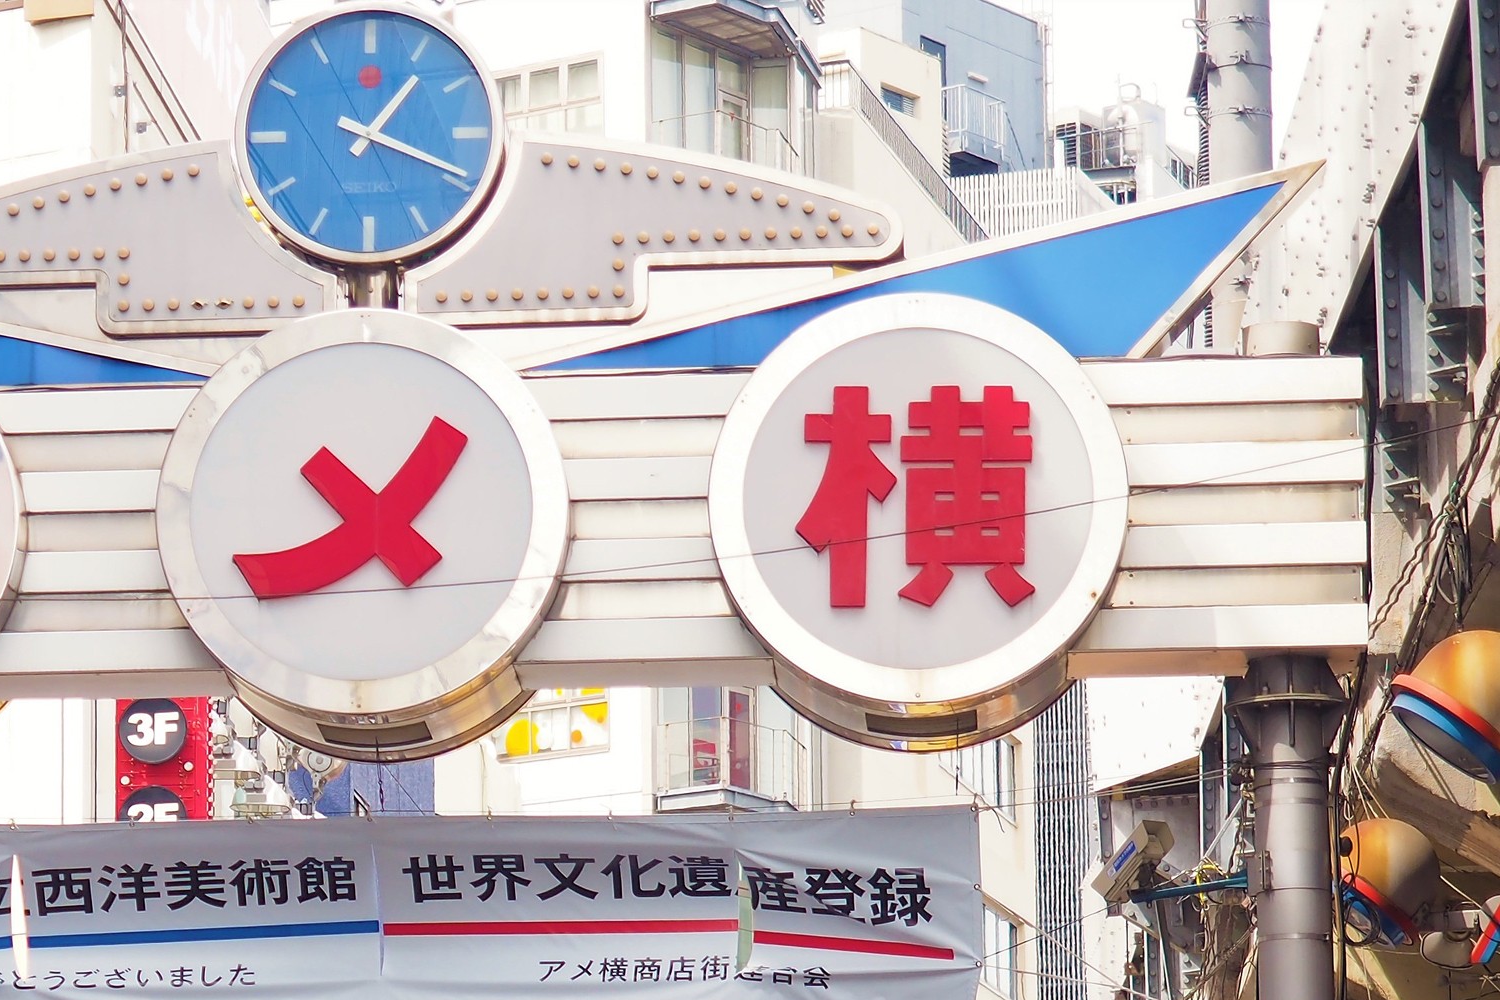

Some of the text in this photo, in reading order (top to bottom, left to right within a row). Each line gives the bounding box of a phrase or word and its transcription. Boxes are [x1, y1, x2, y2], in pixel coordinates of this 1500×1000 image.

[343, 182, 397, 193] SEIKO
[127, 711, 178, 745] 3F
[402, 853, 933, 928] 世界文化遺産登録
